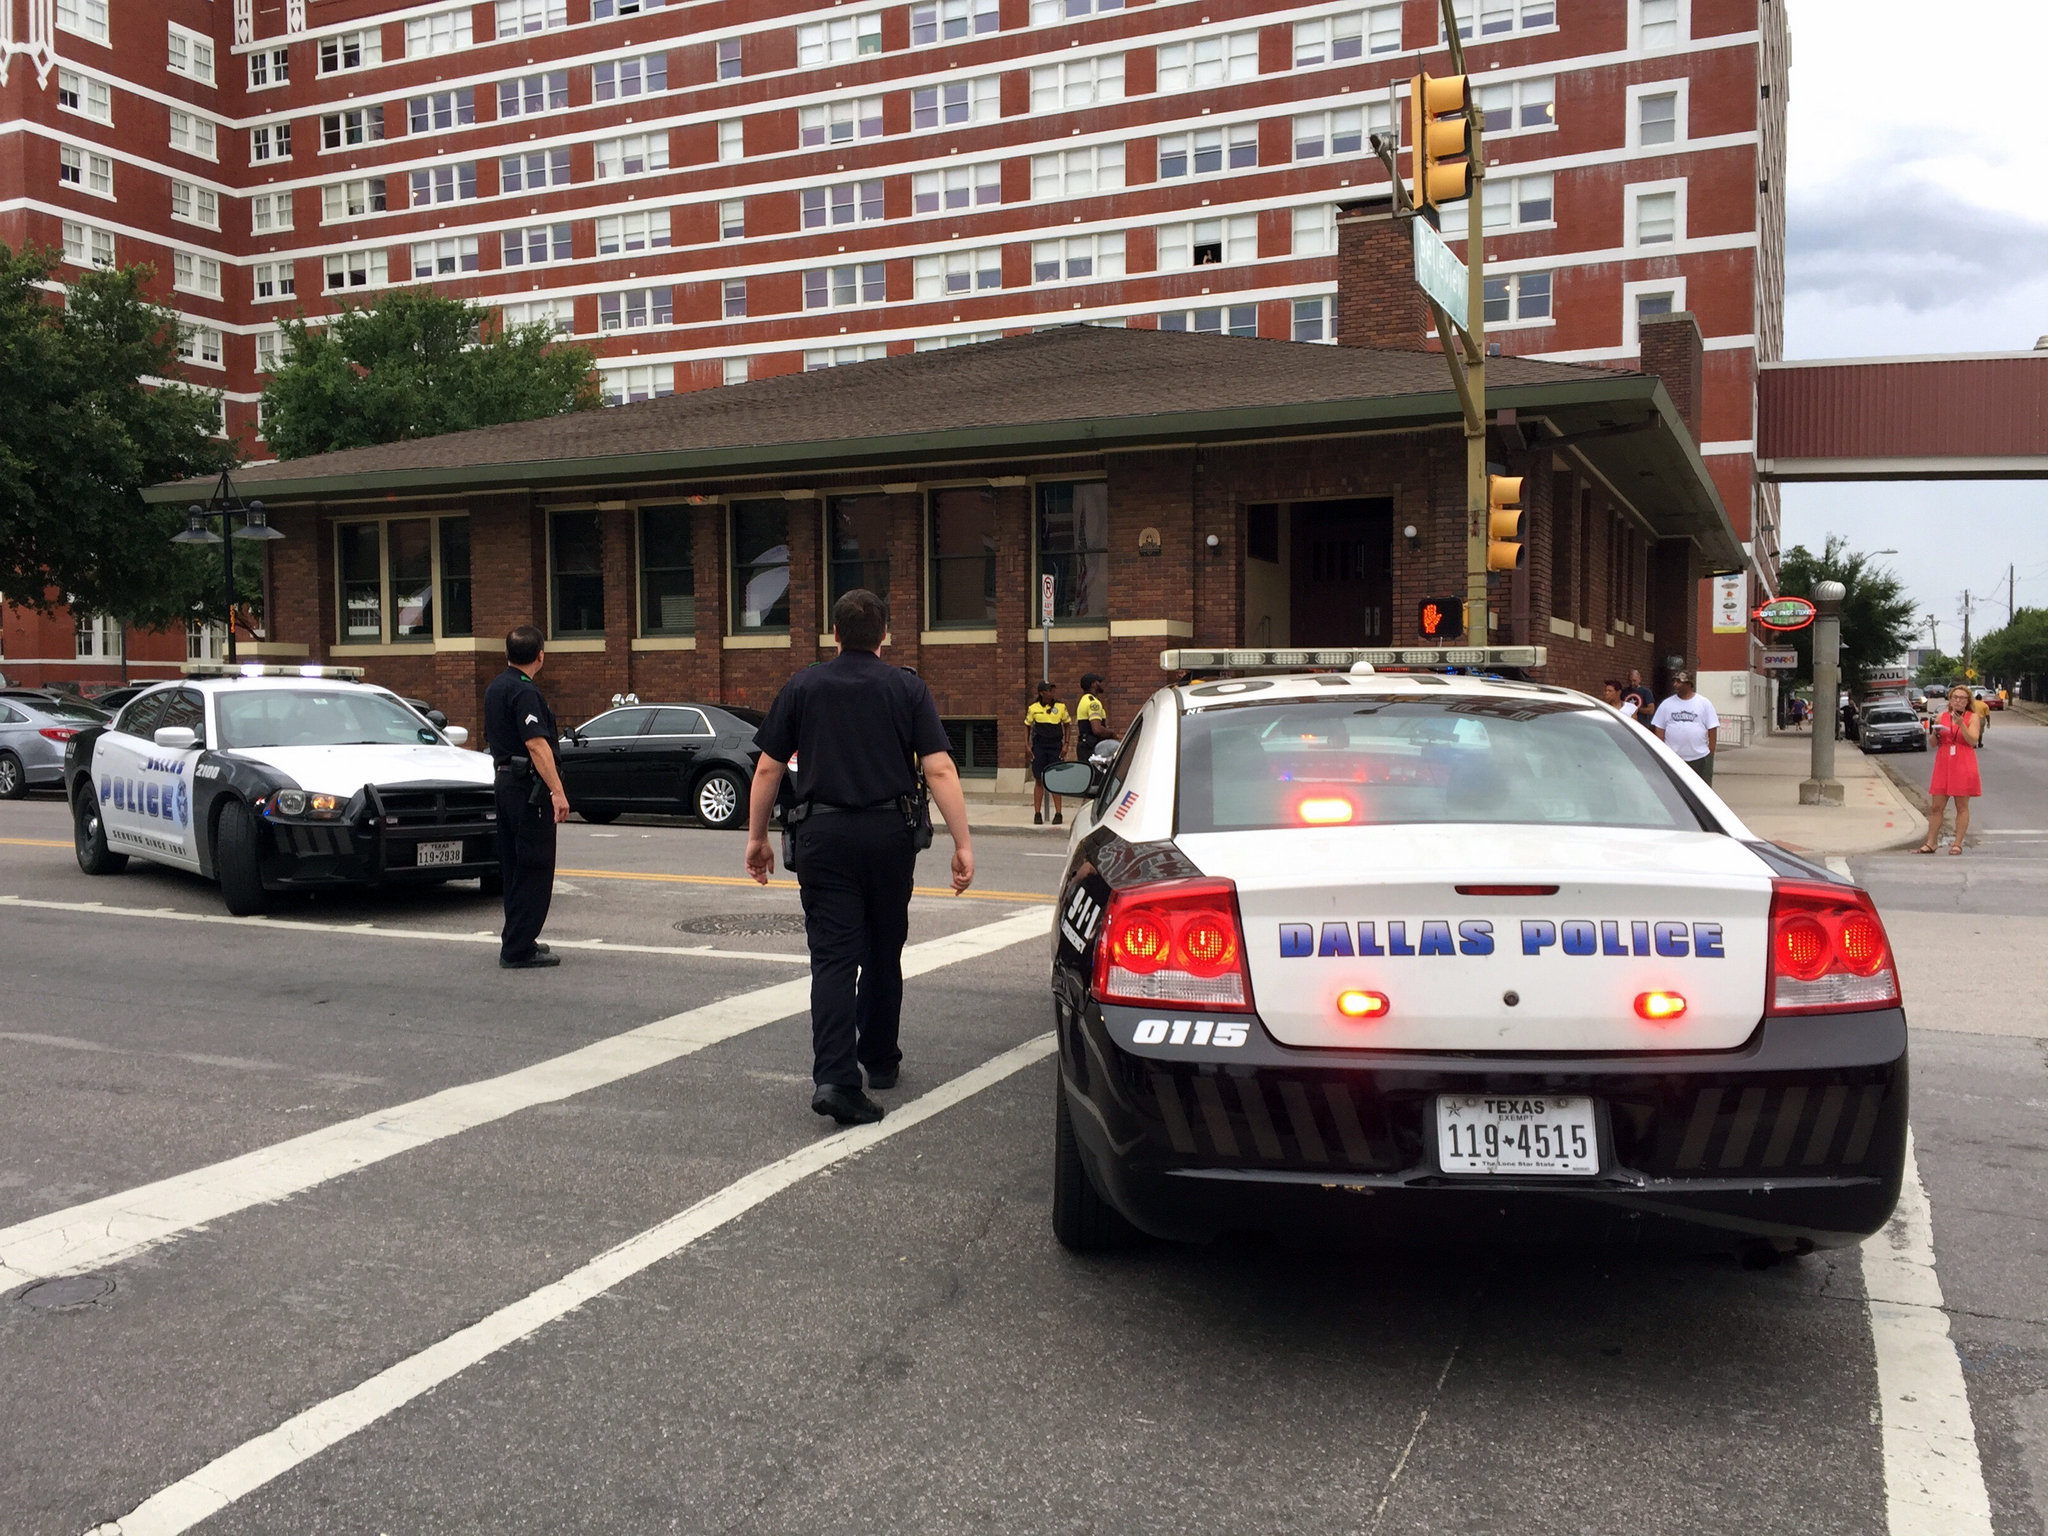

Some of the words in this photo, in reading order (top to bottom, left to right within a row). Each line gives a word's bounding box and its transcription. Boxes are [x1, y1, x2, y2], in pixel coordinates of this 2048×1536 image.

[147, 756, 185, 775] DALLAS
[195, 763, 221, 780] 2100
[100, 773, 174, 821] POLICE
[112, 830, 143, 844] SERVING
[145, 837, 166, 851] SINCE
[1278, 920, 1495, 958] DALLAS
[1520, 919, 1726, 958] POLICE
[1132, 1018, 1251, 1048] 0115
[1484, 1099, 1545, 1115] TEXAS
[1498, 1114, 1534, 1122] EXEMPT
